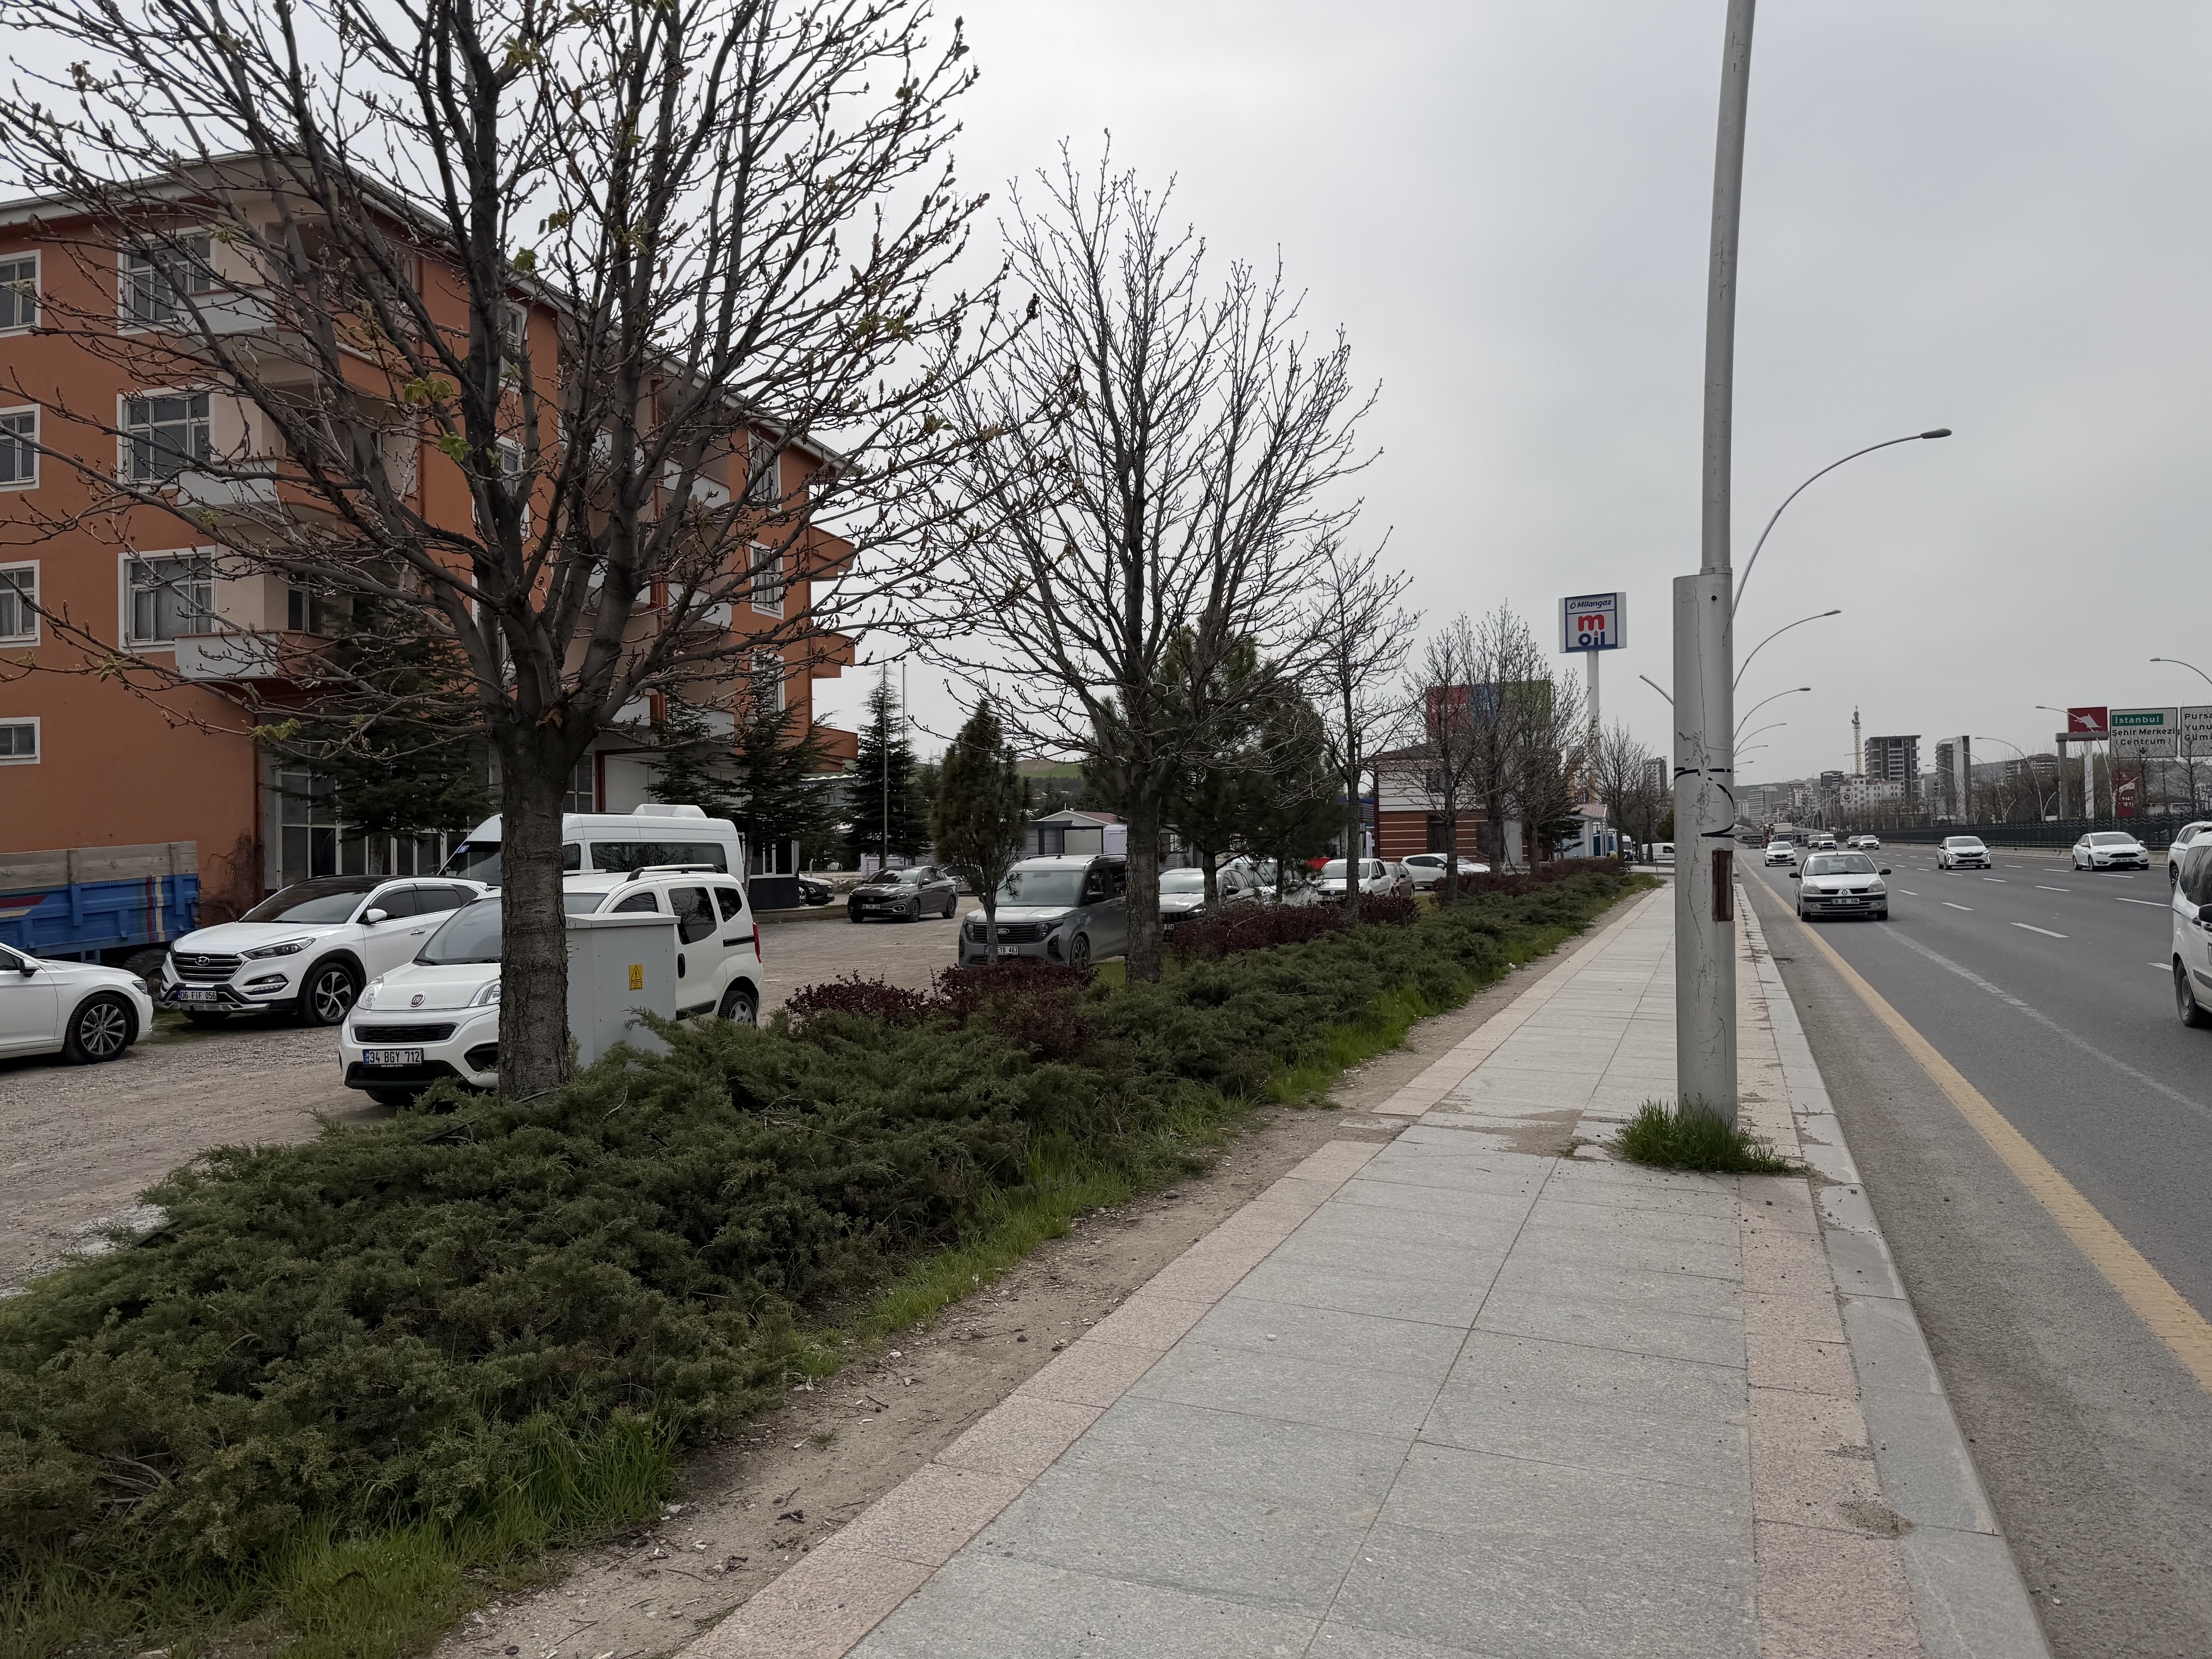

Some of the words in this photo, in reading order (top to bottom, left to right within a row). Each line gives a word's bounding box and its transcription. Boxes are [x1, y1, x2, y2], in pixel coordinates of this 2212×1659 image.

[1577, 600, 1612, 608] Milangaz
[370, 1052, 380, 1063] 34
[385, 1051, 400, 1063] BGY
[405, 1051, 420, 1062] 712
